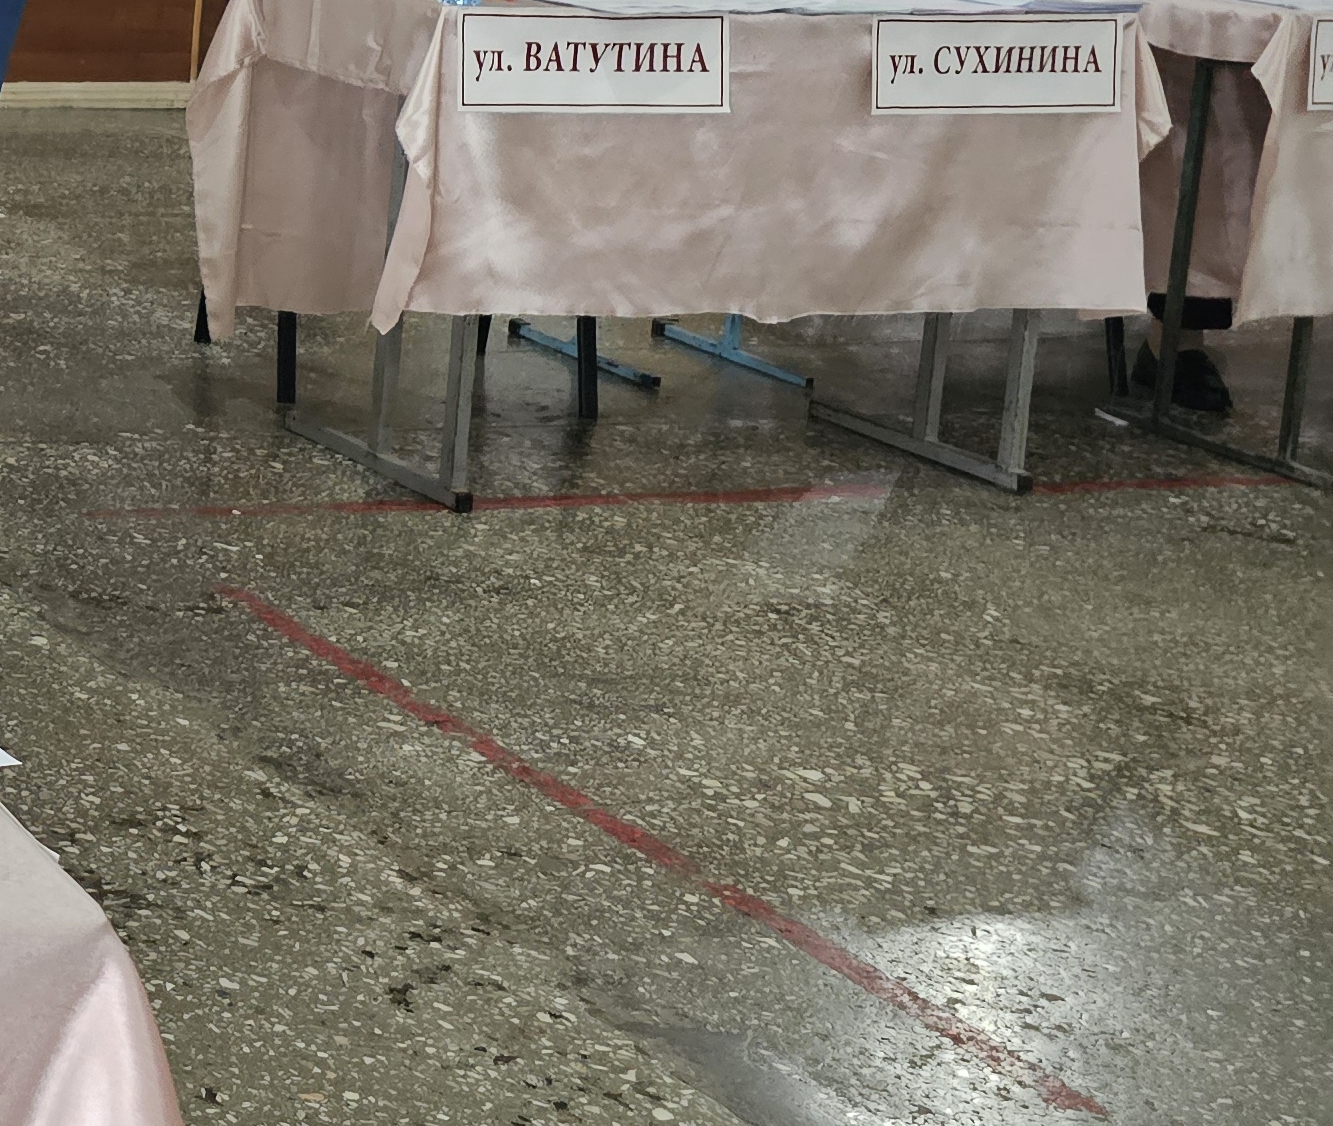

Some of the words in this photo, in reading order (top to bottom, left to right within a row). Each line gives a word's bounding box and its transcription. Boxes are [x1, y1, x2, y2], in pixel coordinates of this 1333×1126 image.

[473, 49, 513, 82] ул.
[523, 41, 710, 73] ВАТУТИНА
[889, 53, 924, 84] ул.
[933, 44, 1102, 74] СУХИНИНА
